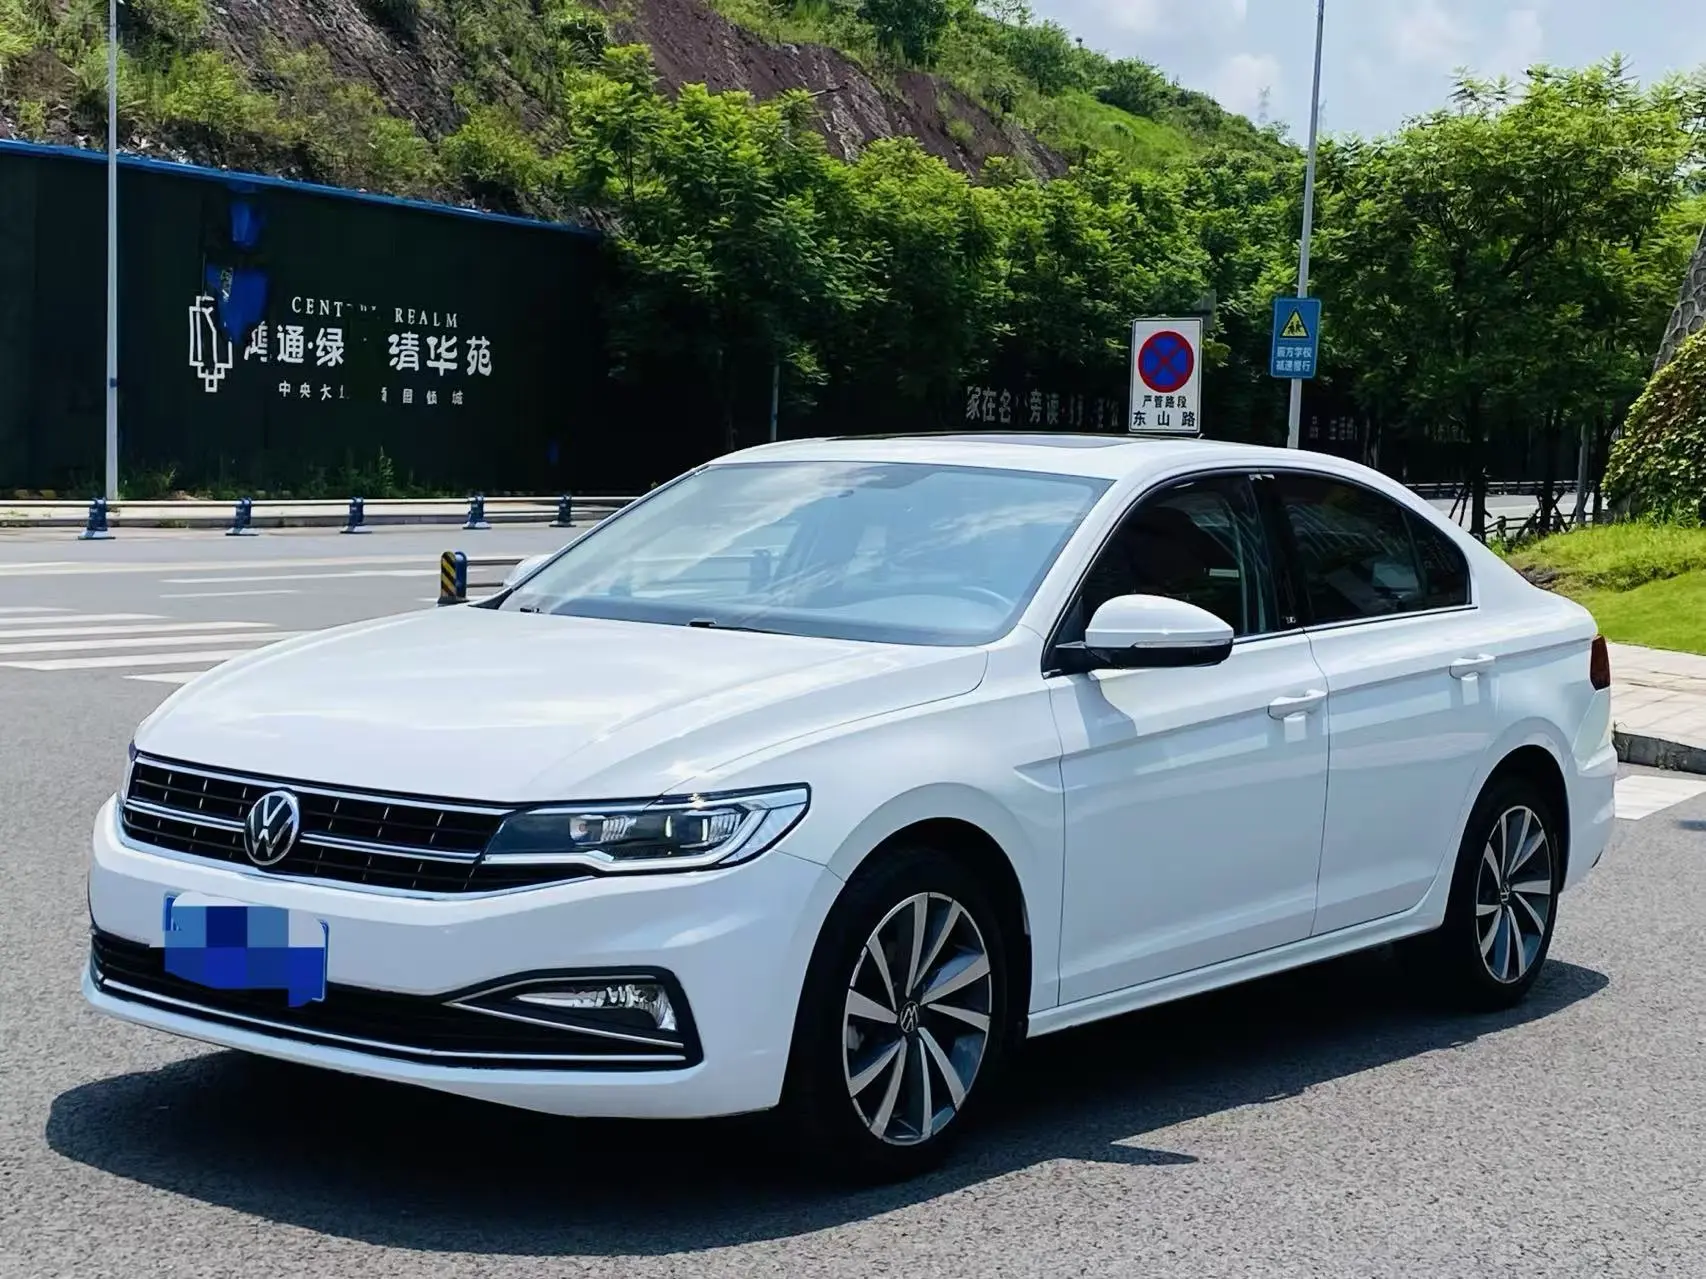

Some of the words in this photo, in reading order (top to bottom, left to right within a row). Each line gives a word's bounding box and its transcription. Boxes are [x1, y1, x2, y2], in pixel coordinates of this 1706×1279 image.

[292, 297, 376, 317] CENT
[395, 307, 458, 328] REALM
[1142, 395, 1187, 408] 严管路段
[1133, 410, 1195, 427] 东山路
